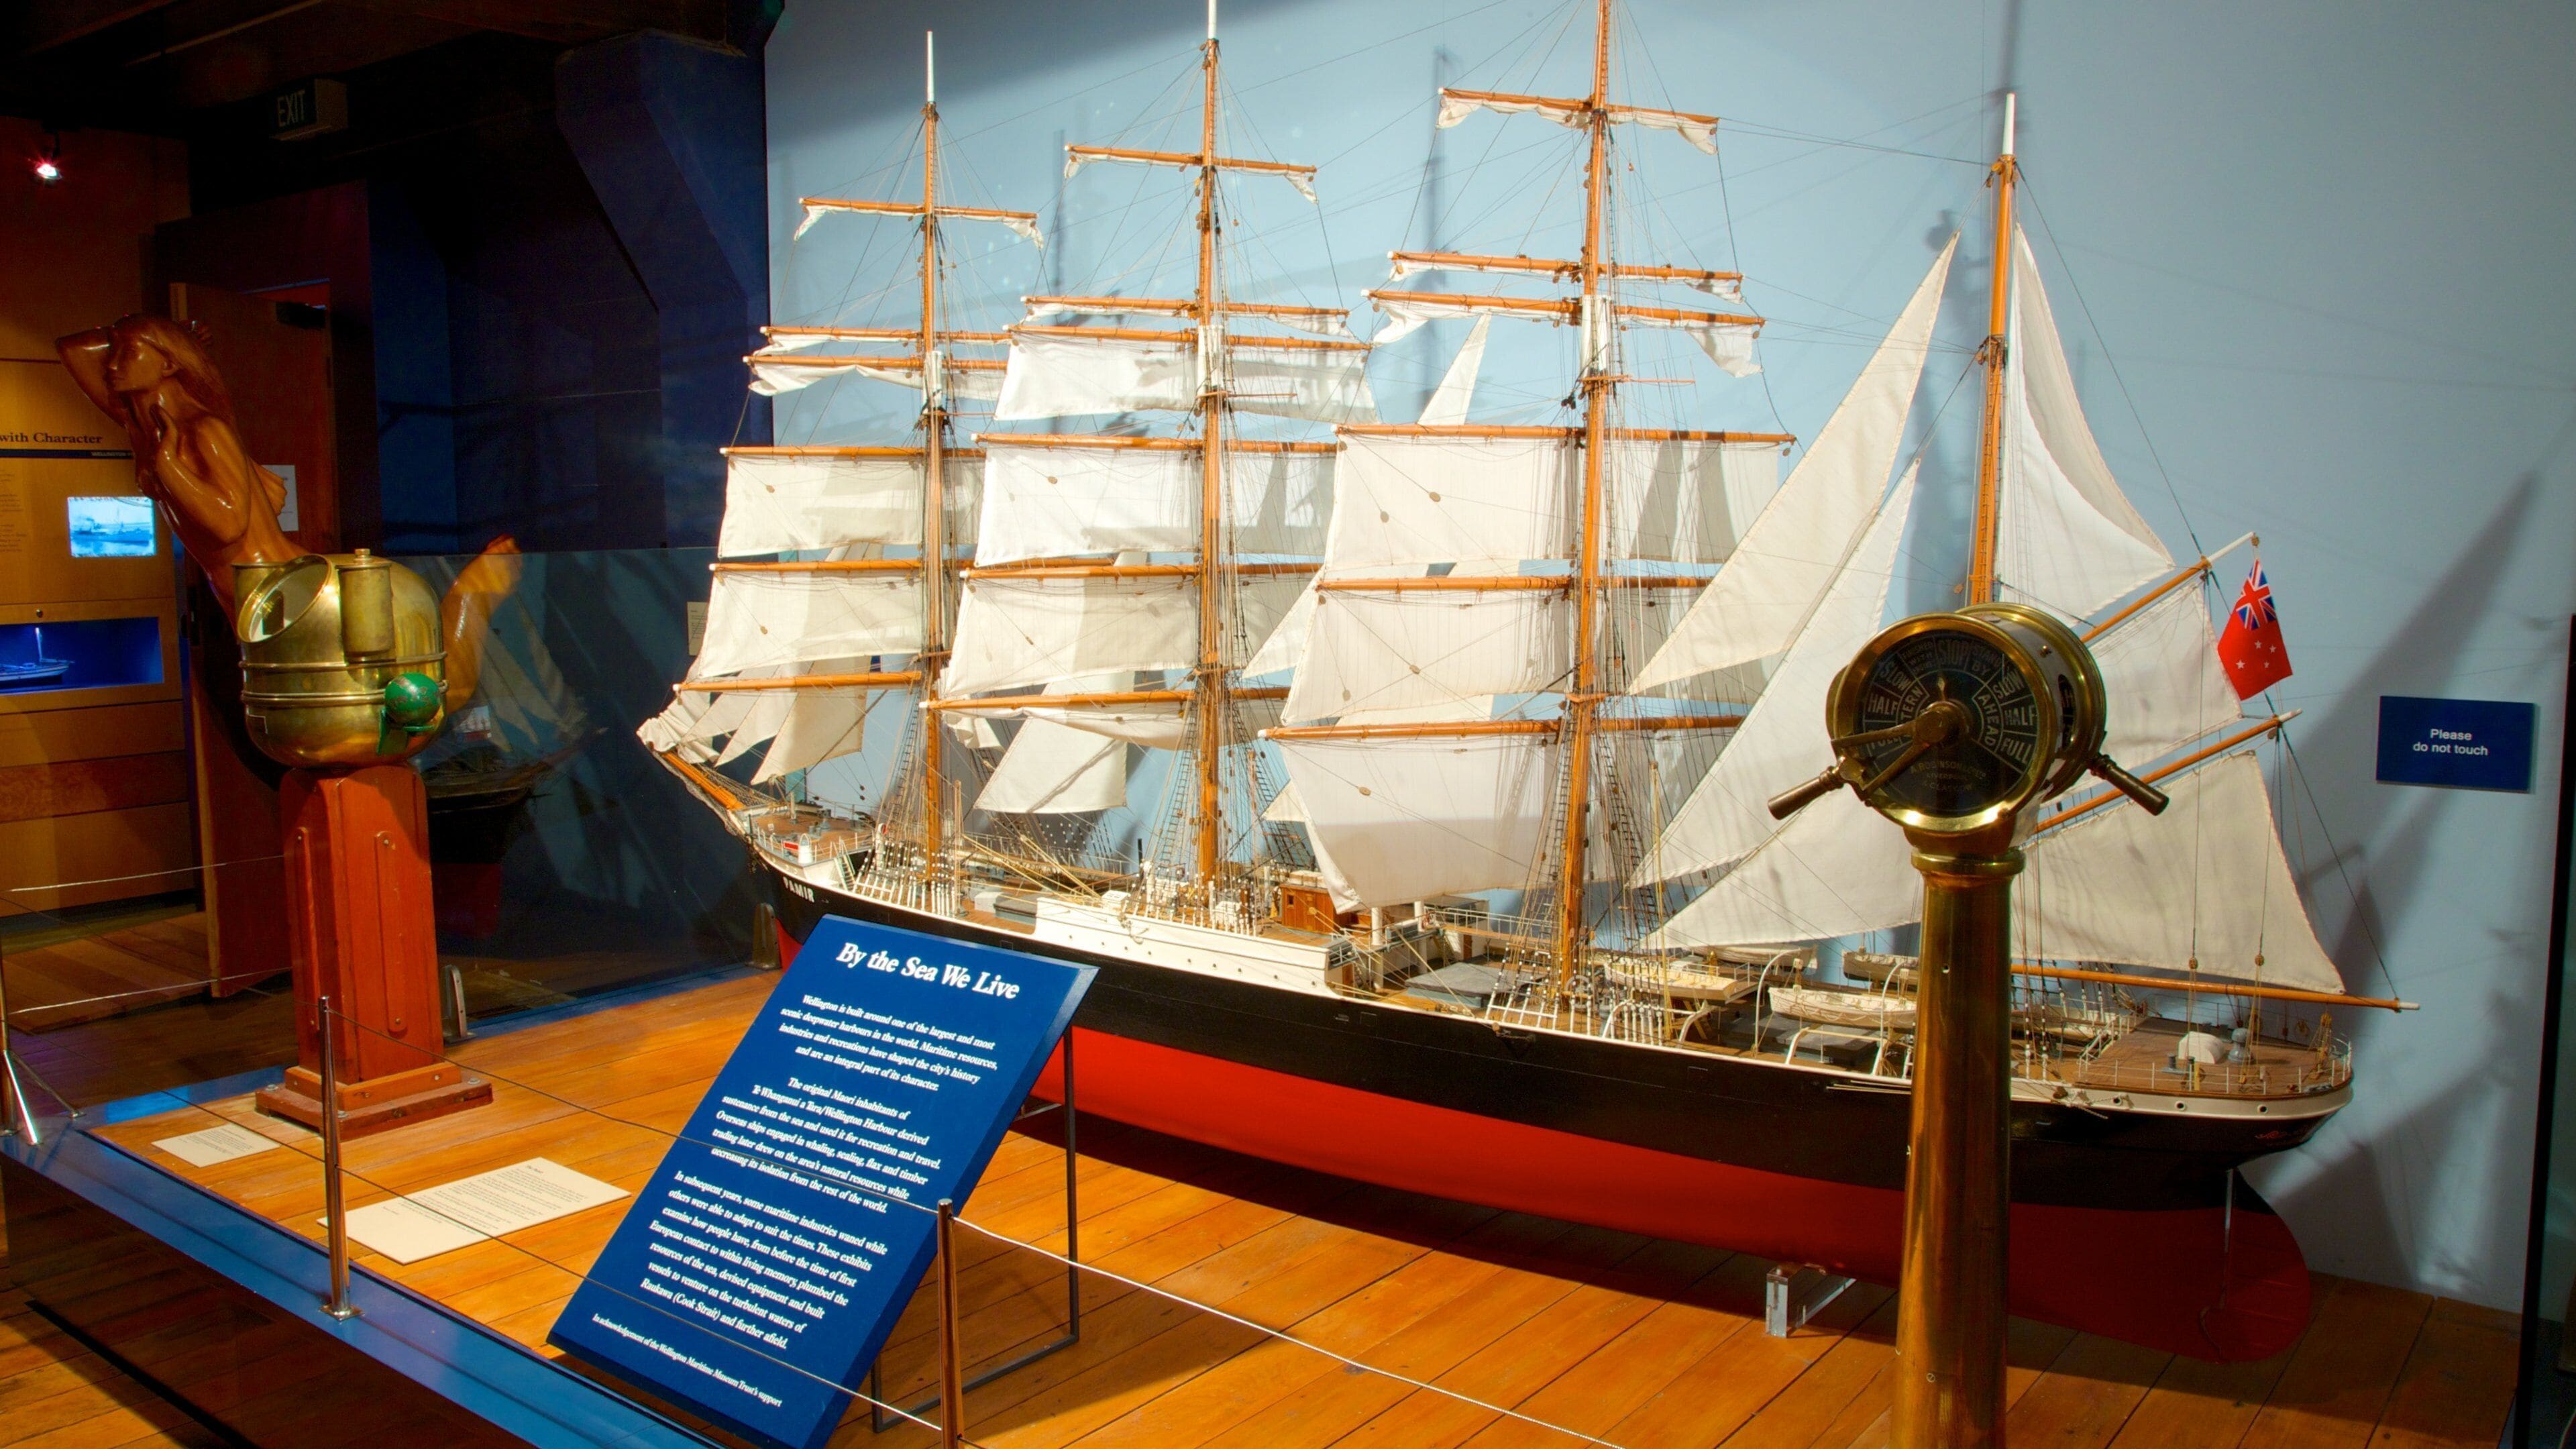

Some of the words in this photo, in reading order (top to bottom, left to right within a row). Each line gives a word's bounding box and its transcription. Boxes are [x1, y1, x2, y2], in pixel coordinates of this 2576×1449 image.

[277, 89, 305, 127] EXIT
[0, 432, 29, 443] with
[34, 432, 103, 444] Character
[1879, 659, 1912, 692] SLOW
[1938, 639, 1971, 665] STOP
[1868, 692, 1898, 716] HALF
[1992, 666, 2025, 699] SLOW
[1978, 694, 1999, 746] AHEAD
[2004, 704, 2037, 726] HALF
[2430, 729, 2472, 741] Please
[2000, 738, 2032, 763] FULL
[2413, 741, 2428, 752] do
[2432, 743, 2451, 753] not
[2455, 745, 2489, 756] touch
[782, 876, 815, 903] PAMIR
[836, 943, 867, 968] By
[867, 951, 899, 972] the
[901, 957, 938, 981] Sea
[942, 965, 970, 988] We
[972, 972, 1019, 999] Live
[781, 1009, 802, 1019] scenic
[802, 1013, 840, 1028] deepwater
[839, 1022, 872, 1036] harbours
[872, 1030, 881, 1039] in
[881, 1033, 895, 1042] the
[896, 1038, 919, 1049] world.
[919, 1042, 957, 1059] Maritime
[957, 1054, 997, 1070] resources,
[803, 995, 839, 1011] Wellington
[838, 1004, 846, 1013] is
[846, 1006, 864, 1017] built
[863, 1013, 892, 1024] around
[891, 1020, 906, 1028] one
[916, 1024, 929, 1033] the
[928, 1026, 957, 1040] largest
[956, 1036, 974, 1044] and
[973, 1039, 995, 1049] most
[779, 1023, 814, 1038] industries
[814, 1034, 830, 1042] and
[828, 1038, 869, 1053] recreations
[869, 1046, 888, 1059] have
[888, 1053, 916, 1066] shaped
[916, 1059, 929, 1069] the
[950, 1068, 980, 1084] history
[752, 1085, 761, 1094] Te
[761, 1087, 801, 1106] Whanganui
[806, 1101, 863, 1126] Tara/Wellington
[863, 1118, 898, 1136] Harbour
[898, 1130, 929, 1145] derived
[788, 1077, 802, 1089] The
[802, 1085, 833, 1097] original
[830, 1091, 856, 1104] Maori
[855, 1097, 898, 1117] inhabitants
[898, 1112, 910, 1120] of
[716, 1111, 747, 1127] Overseas
[747, 1122, 766, 1133] ships
[766, 1129, 797, 1142] engaged
[796, 1136, 804, 1146] in
[806, 1140, 835, 1157] whaling,
[837, 1151, 864, 1167] sealing,
[865, 1159, 882, 1171] flax
[882, 1166, 900, 1176] and
[899, 1170, 928, 1185] timber
[722, 1097, 760, 1112] sustenance
[759, 1106, 778, 1118] from
[778, 1112, 791, 1122] the
[790, 1118, 804, 1126] sea
[804, 1122, 820, 1131] and
[819, 1126, 839, 1137] used
[845, 1132, 858, 1142] for
[857, 1138, 898, 1156] recreation
[898, 1151, 916, 1161] and
[915, 1155, 941, 1169] travel.
[712, 1129, 739, 1144] trading
[737, 1136, 756, 1148] later
[755, 1142, 774, 1154] drew
[774, 1150, 784, 1159] on
[785, 1152, 798, 1163] the
[820, 1166, 850, 1180] natural
[849, 1175, 886, 1192] resources
[886, 1186, 910, 1200] while
[668, 1191, 690, 1203] others
[691, 1199, 708, 1210] were
[708, 1204, 724, 1215] able
[724, 1210, 733, 1218] to
[733, 1214, 755, 1227] adapt
[754, 1222, 763, 1230] to
[763, 1226, 779, 1236] suit
[779, 1230, 792, 1241] the
[792, 1236, 814, 1250] times.
[816, 1242, 840, 1258] These
[840, 1254, 871, 1271] exhibits
[674, 1171, 684, 1181] In
[684, 1177, 722, 1195] subsequent
[720, 1190, 742, 1203] years,
[743, 1198, 763, 1210] some
[763, 1205, 799, 1223] maritime
[799, 1216, 837, 1237] industries
[839, 1232, 865, 1246] waned
[865, 1242, 887, 1254] while
[649, 1220, 683, 1240] European
[683, 1236, 710, 1251] contact
[710, 1246, 718, 1254] to
[719, 1250, 742, 1264] within
[742, 1257, 764, 1274] living
[763, 1268, 798, 1287] memory,
[796, 1281, 835, 1300] plumbed
[834, 1294, 848, 1305] the
[662, 1208, 692, 1223] examine
[691, 1217, 708, 1229] how
[706, 1225, 732, 1238] people
[731, 1232, 749, 1248] have,
[750, 1240, 770, 1254] from
[771, 1247, 796, 1263] before
[796, 1257, 809, 1269] the
[810, 1263, 828, 1276] time
[829, 1271, 841, 1280] of
[838, 1273, 857, 1287] first
[649, 1263, 672, 1277] vessels
[672, 1272, 680, 1281] to
[681, 1277, 708, 1292] venture
[708, 1289, 718, 1297] on
[718, 1291, 732, 1302] the
[732, 1297, 768, 1318] turbulent
[768, 1313, 794, 1328] waters
[794, 1324, 807, 1333] of
[650, 1243, 683, 1260] resources
[683, 1256, 694, 1265] of
[692, 1258, 704, 1269] the
[704, 1265, 717, 1277] sea,
[718, 1270, 749, 1287] devised
[747, 1283, 788, 1304] equipment
[788, 1299, 806, 1311] and
[804, 1303, 824, 1319] built
[641, 1279, 673, 1299] Raukawa
[673, 1293, 696, 1309] (Cook
[695, 1302, 720, 1320] Strait)
[720, 1315, 737, 1326] and
[735, 1320, 764, 1338] further
[763, 1334, 788, 1349] afield.
